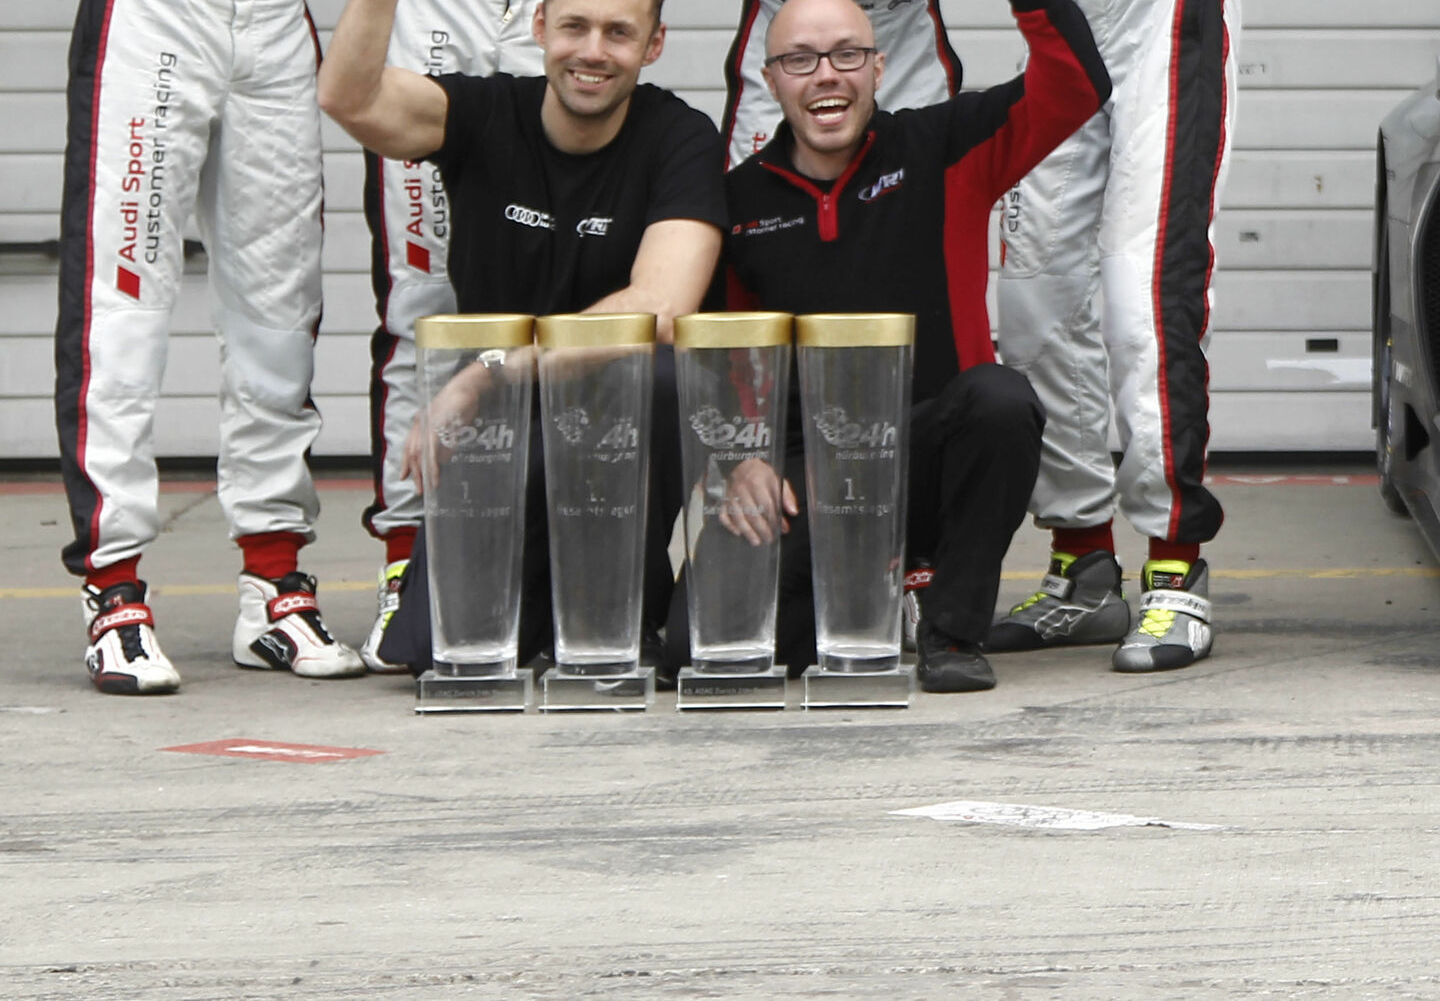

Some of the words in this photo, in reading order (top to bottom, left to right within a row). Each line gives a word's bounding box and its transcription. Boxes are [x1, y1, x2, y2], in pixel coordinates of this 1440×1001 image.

[153, 51, 177, 129] racing
[122, 117, 147, 193] Sport
[117, 200, 140, 263] Audi
[145, 138, 167, 265] customer
[403, 178, 424, 238] Audi
[597, 423, 639, 449] 4h
